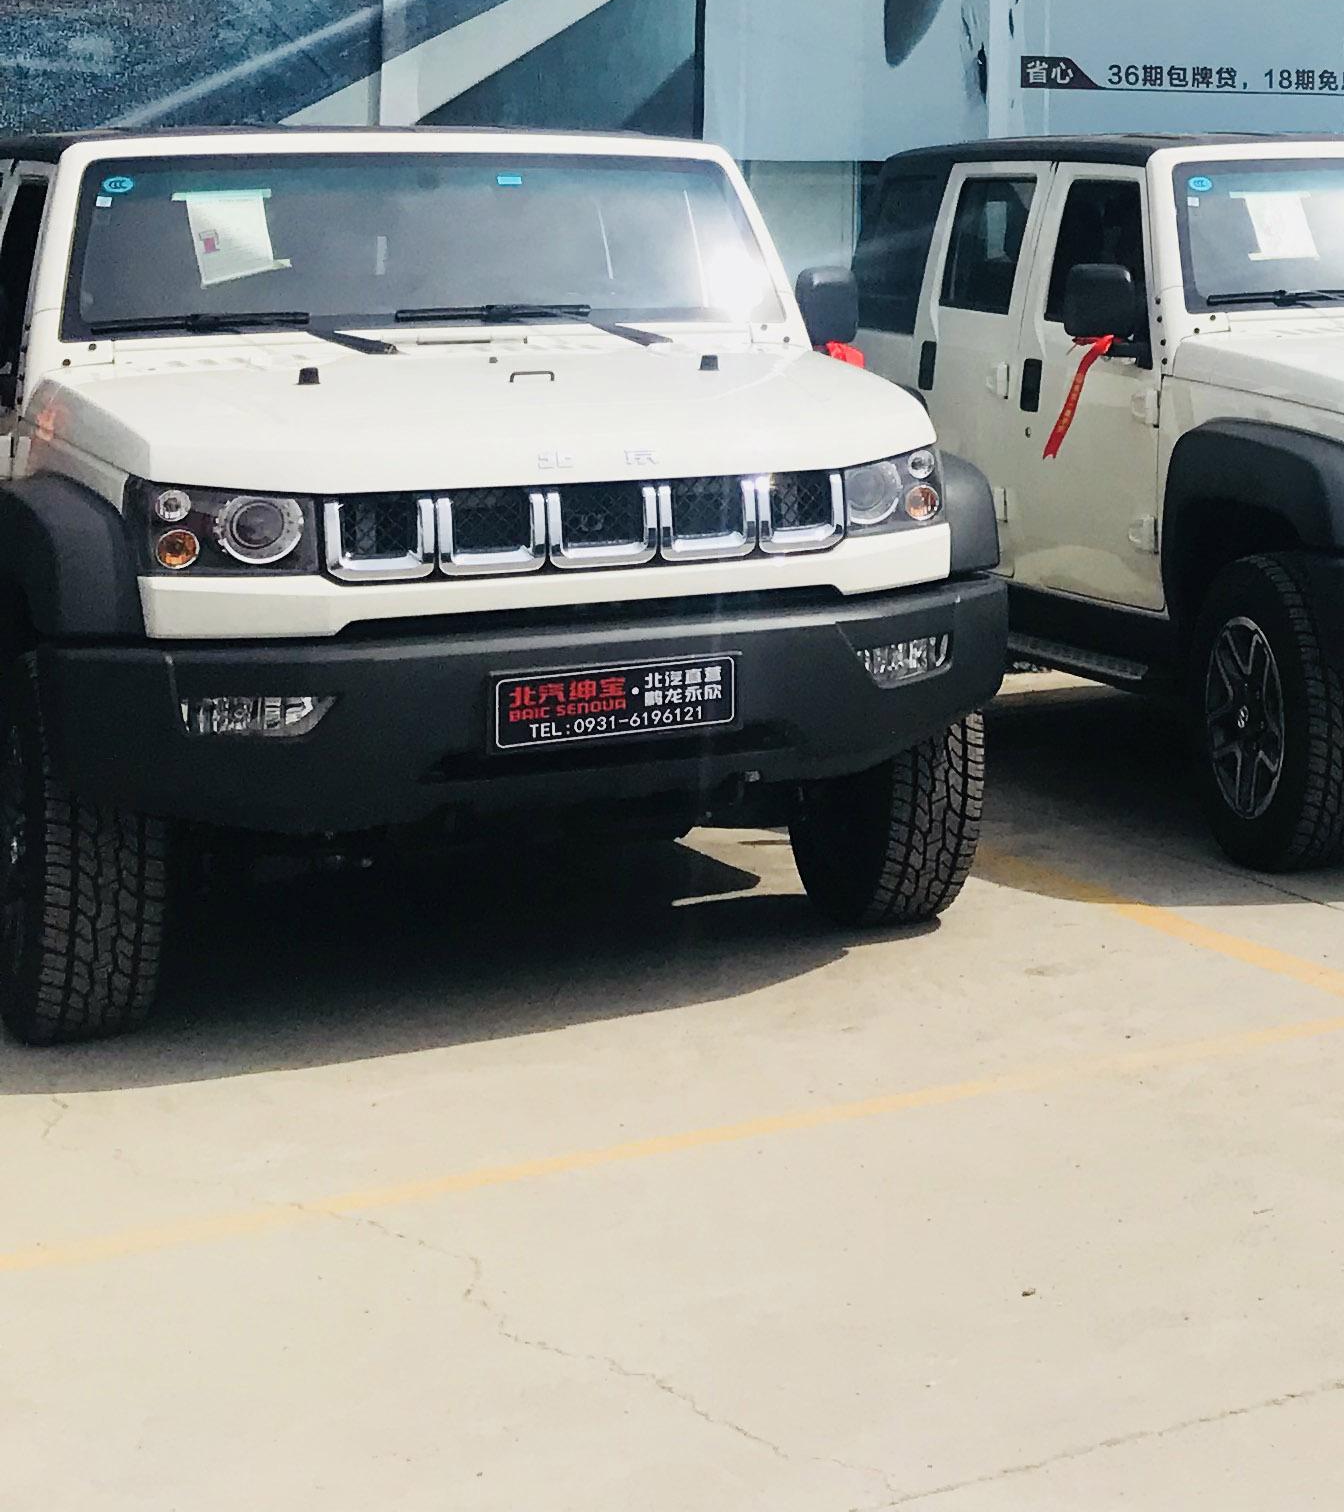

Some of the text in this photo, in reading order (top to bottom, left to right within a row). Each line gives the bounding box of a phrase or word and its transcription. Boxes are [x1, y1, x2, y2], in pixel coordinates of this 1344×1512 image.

[1026, 60, 1074, 87] 省心
[509, 675, 626, 708] 北汽绅宝
[509, 705, 550, 723] BAIC
[529, 705, 703, 739] TEL:0931-6196121
